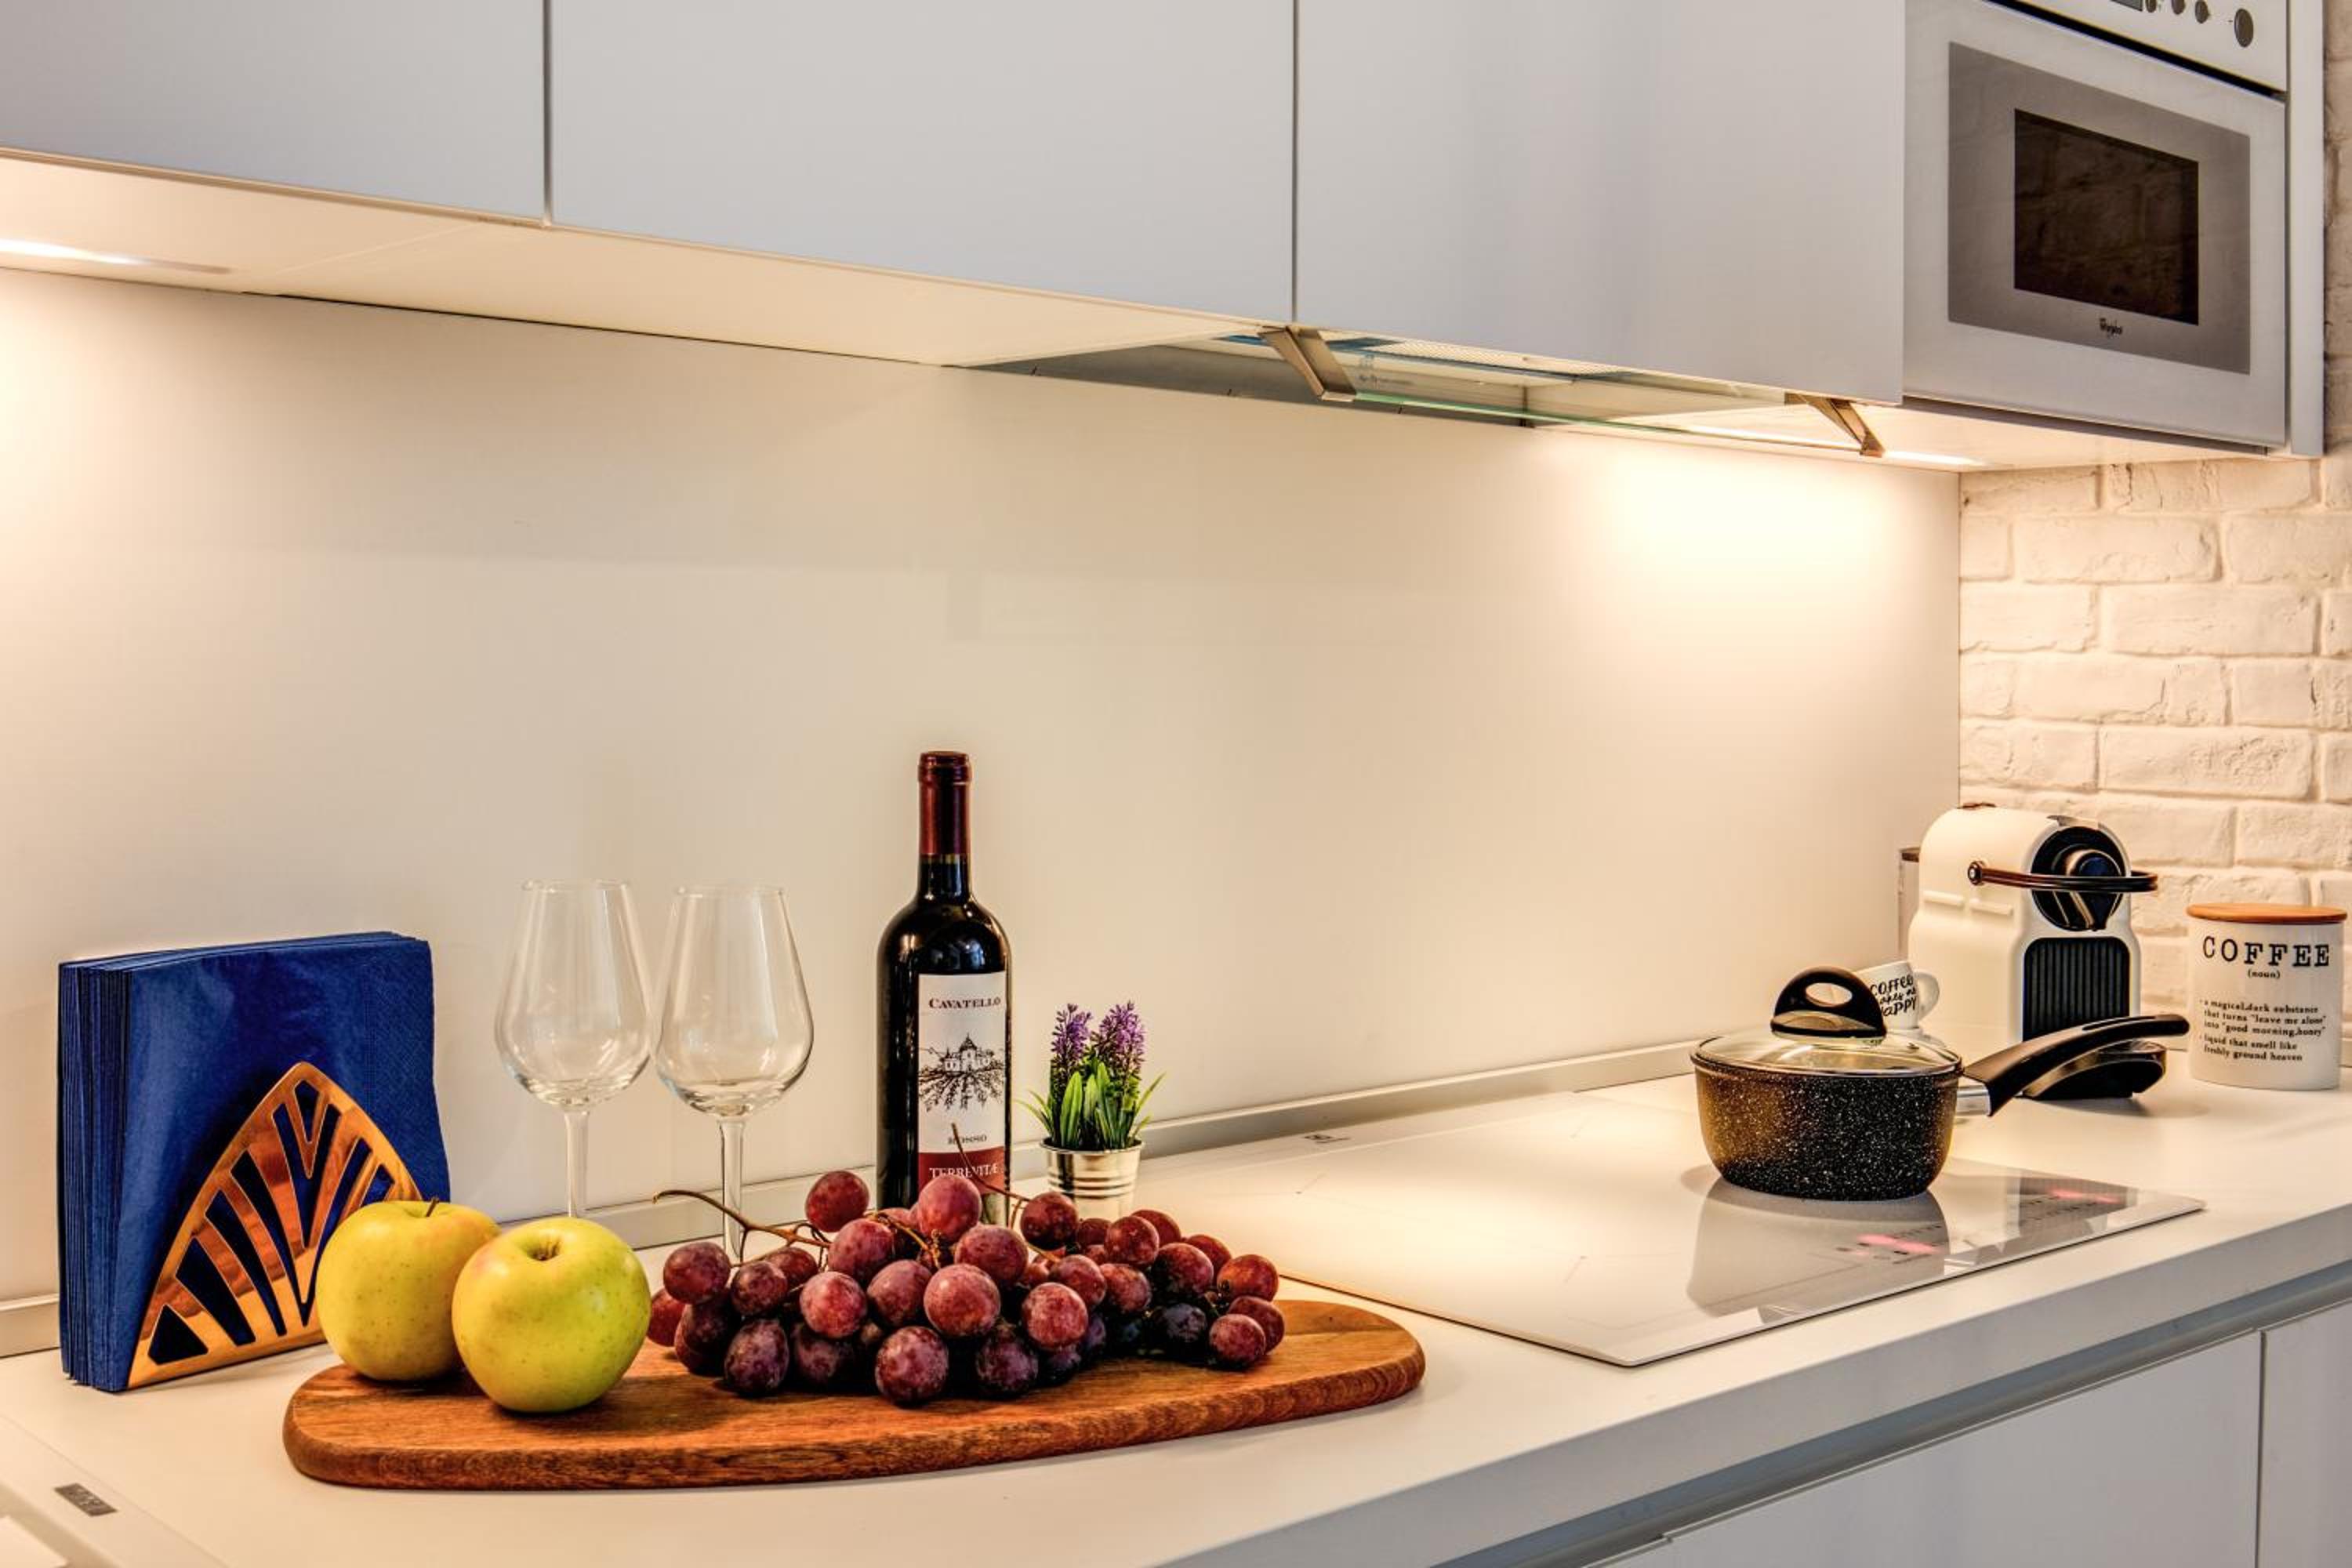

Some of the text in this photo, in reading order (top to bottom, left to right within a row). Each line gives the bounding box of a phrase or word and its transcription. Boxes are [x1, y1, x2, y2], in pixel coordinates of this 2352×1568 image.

[2202, 935, 2329, 967] COFFEE
[2248, 969, 2281, 979] (noun)
[928, 996, 1002, 1010] CAVATELLO
[2204, 1009, 2220, 1018] that
[2223, 1012, 2248, 1022] turns
[2204, 1033, 2227, 1044] liquid
[2229, 1038, 2248, 1047] that
[2204, 1044, 2303, 1061] freshly ground heaven
